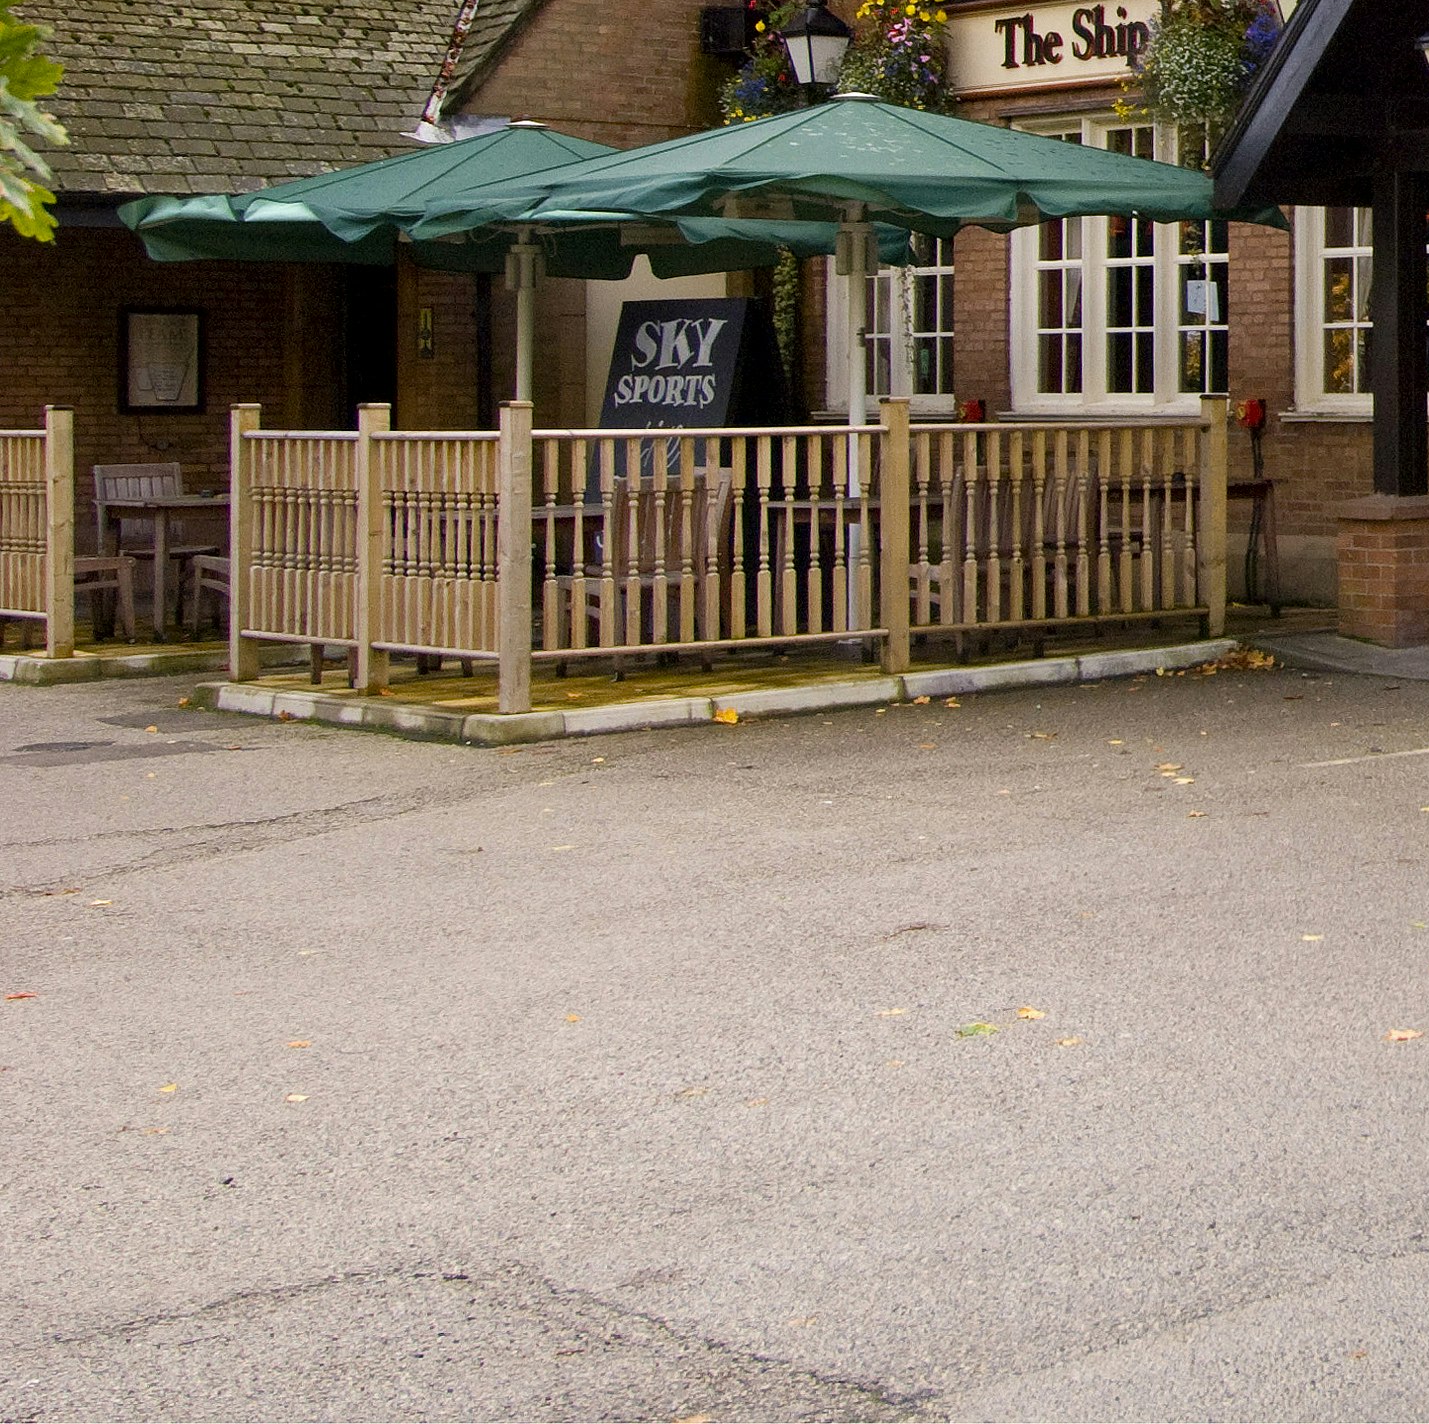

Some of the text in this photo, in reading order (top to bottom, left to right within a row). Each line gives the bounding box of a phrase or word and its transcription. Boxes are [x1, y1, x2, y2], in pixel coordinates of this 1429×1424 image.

[994, 4, 1149, 69] The Ship
[632, 318, 728, 371] SKY
[614, 373, 716, 409] SPORTS
